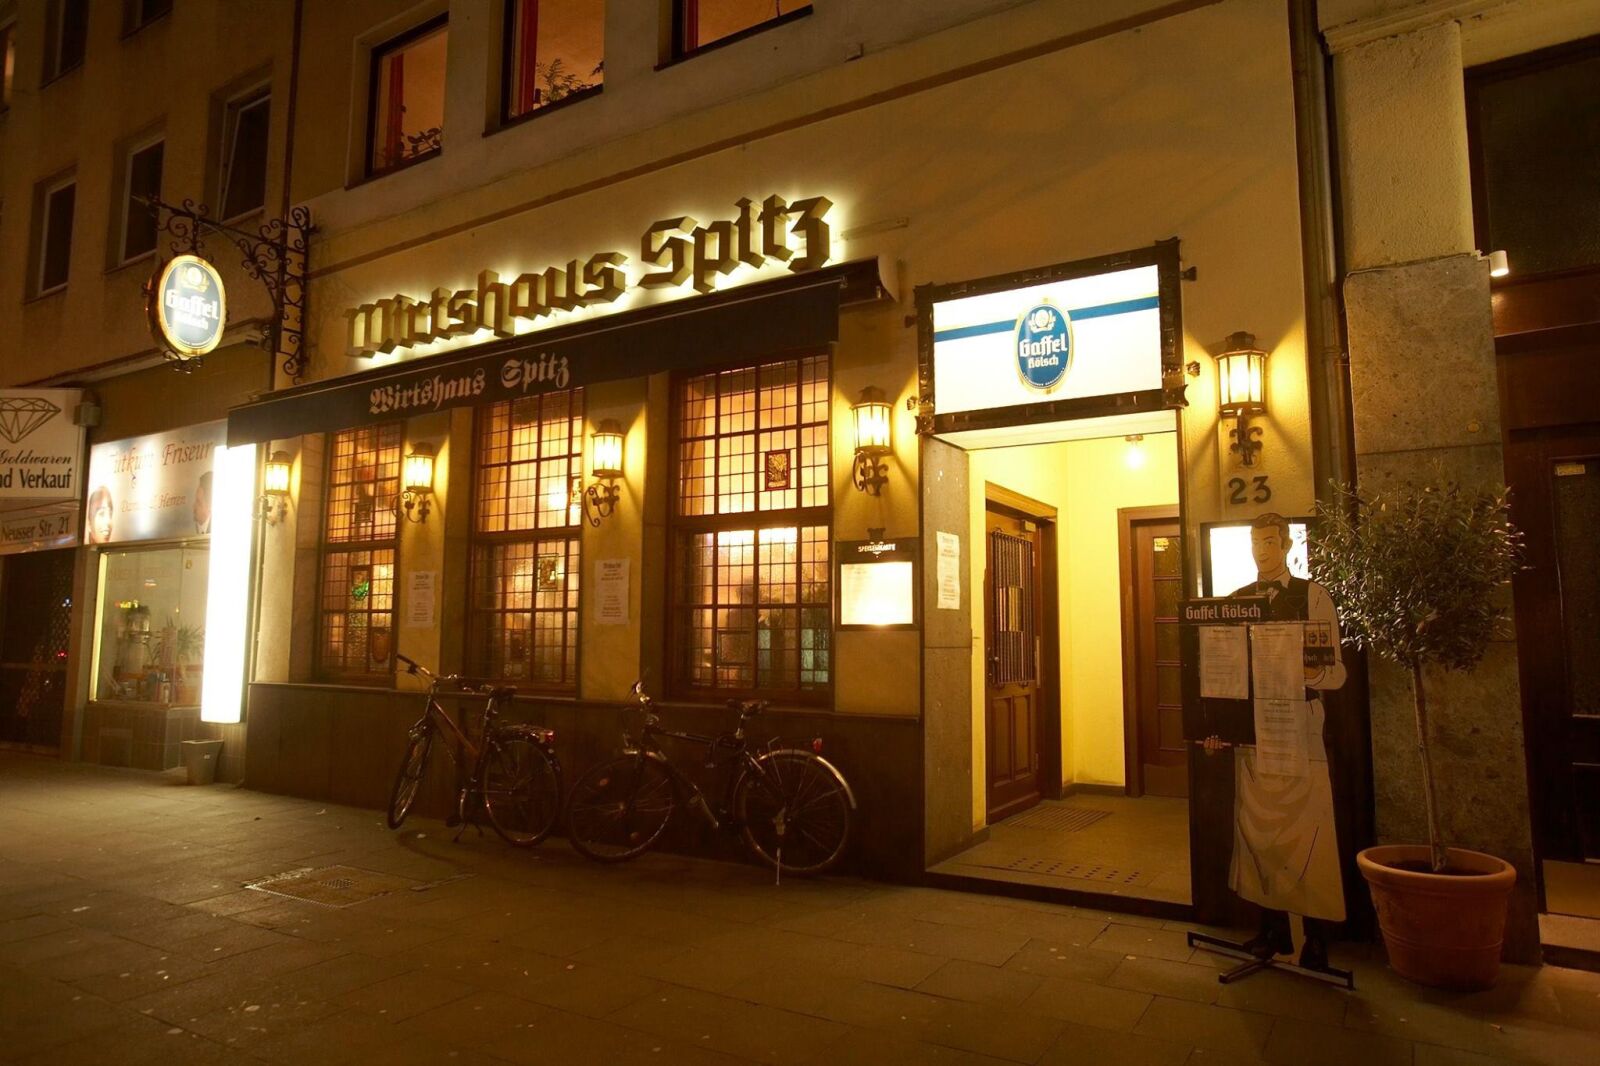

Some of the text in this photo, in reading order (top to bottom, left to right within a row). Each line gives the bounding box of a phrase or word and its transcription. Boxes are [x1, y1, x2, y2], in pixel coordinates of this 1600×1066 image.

[344, 194, 834, 359] Wirtshaus Spitz
[1019, 333, 1068, 358] Gaffel
[1028, 354, 1059, 369] Kölsch
[368, 352, 570, 415] Wirtshaus Spitz
[163, 440, 214, 466] Friseur
[19, 467, 73, 489] Verkauf
[1228, 475, 1272, 505] 23
[1, 516, 71, 542] Neusser Str. 21
[1185, 603, 1261, 620] Gaffel Kölsch
